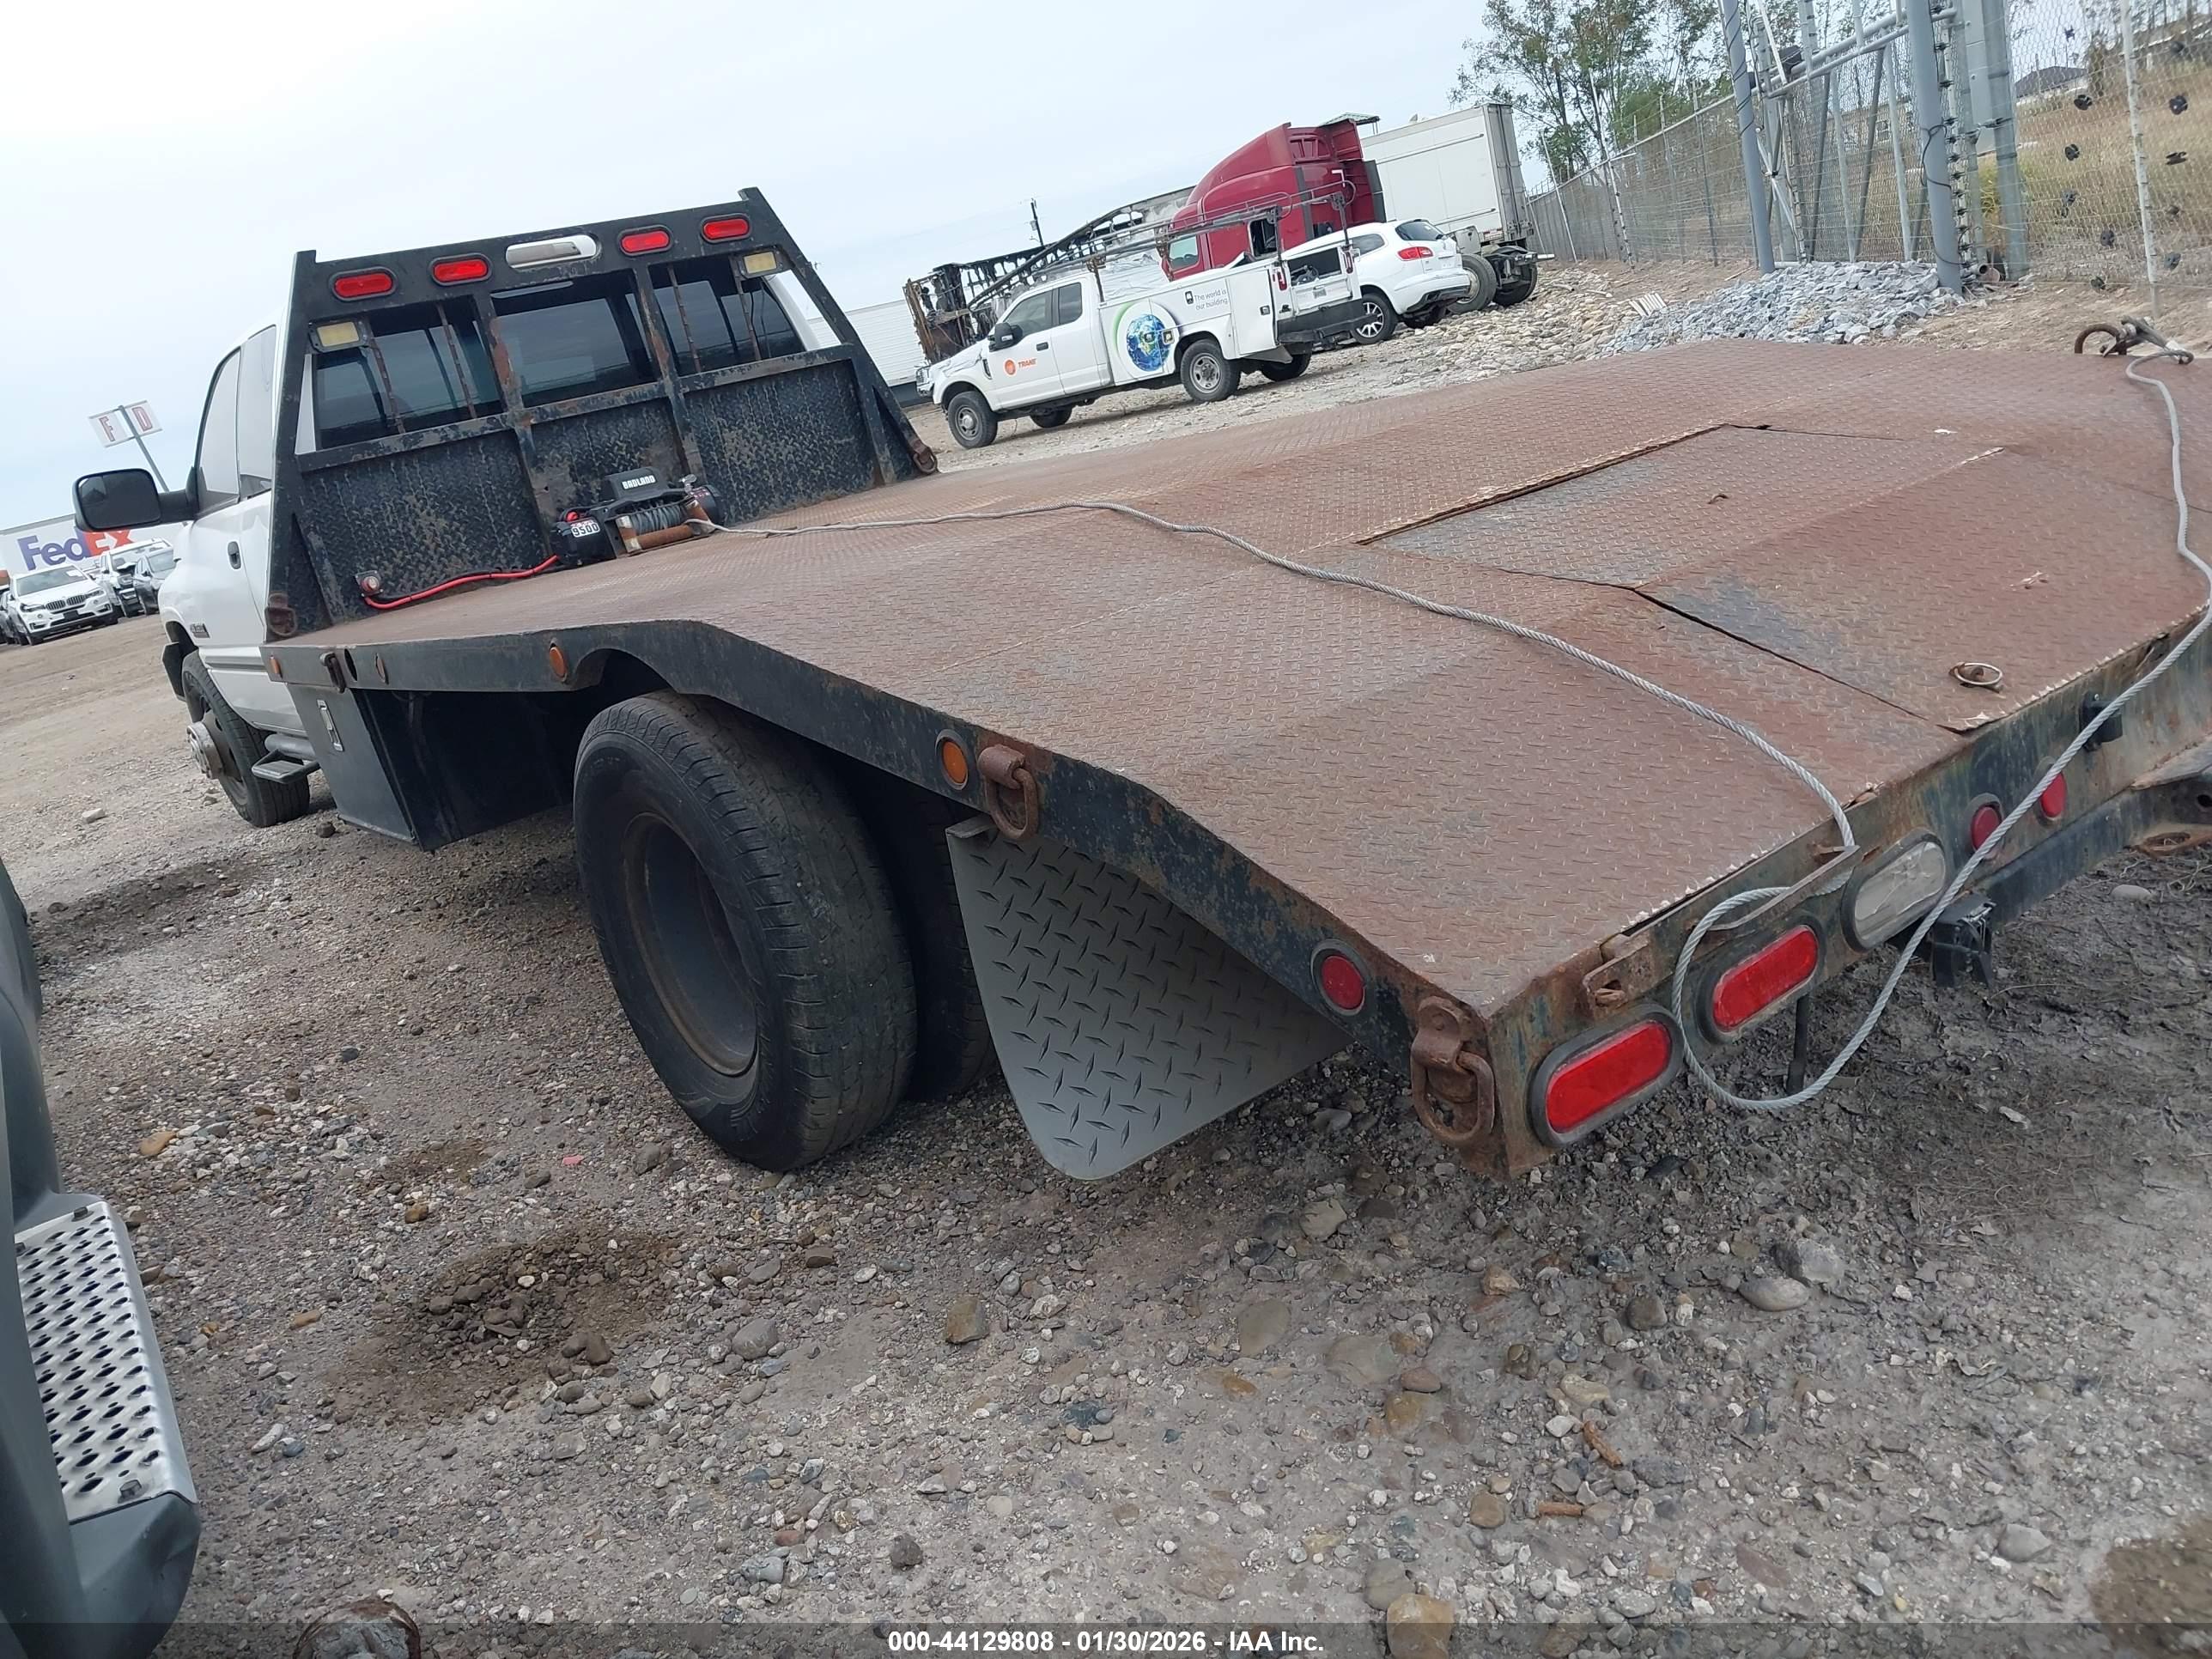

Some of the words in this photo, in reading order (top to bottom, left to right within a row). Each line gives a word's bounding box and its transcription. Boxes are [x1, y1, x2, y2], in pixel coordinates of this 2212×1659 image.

[1206, 289, 1220, 299] world
[1206, 298, 1228, 307] building
[622, 475, 656, 489] BADLAND
[572, 523, 599, 536] 9500
[17, 527, 134, 571] FedEx
